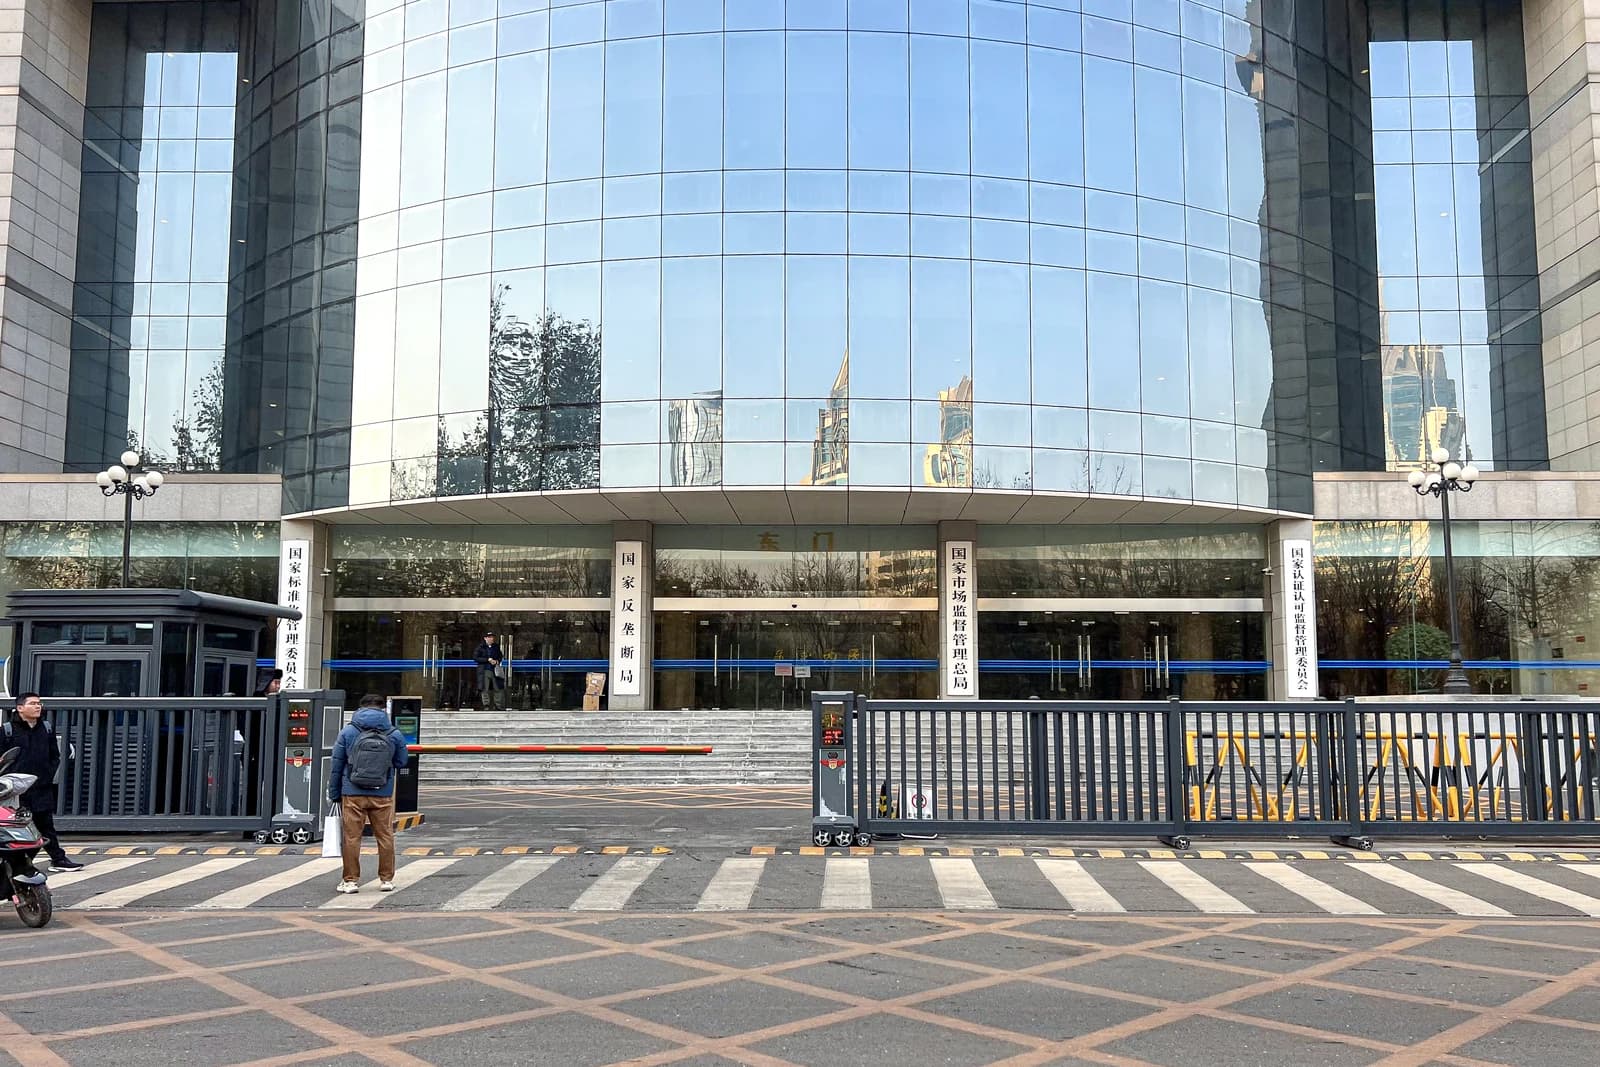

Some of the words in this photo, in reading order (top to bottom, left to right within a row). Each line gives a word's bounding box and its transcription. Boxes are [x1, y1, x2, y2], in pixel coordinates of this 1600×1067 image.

[620, 552, 635, 683] 国家反垄断局
[951, 547, 968, 690] 国家市场监督管理总局
[1291, 547, 1308, 690] 国家认证认可监督管理委员会
